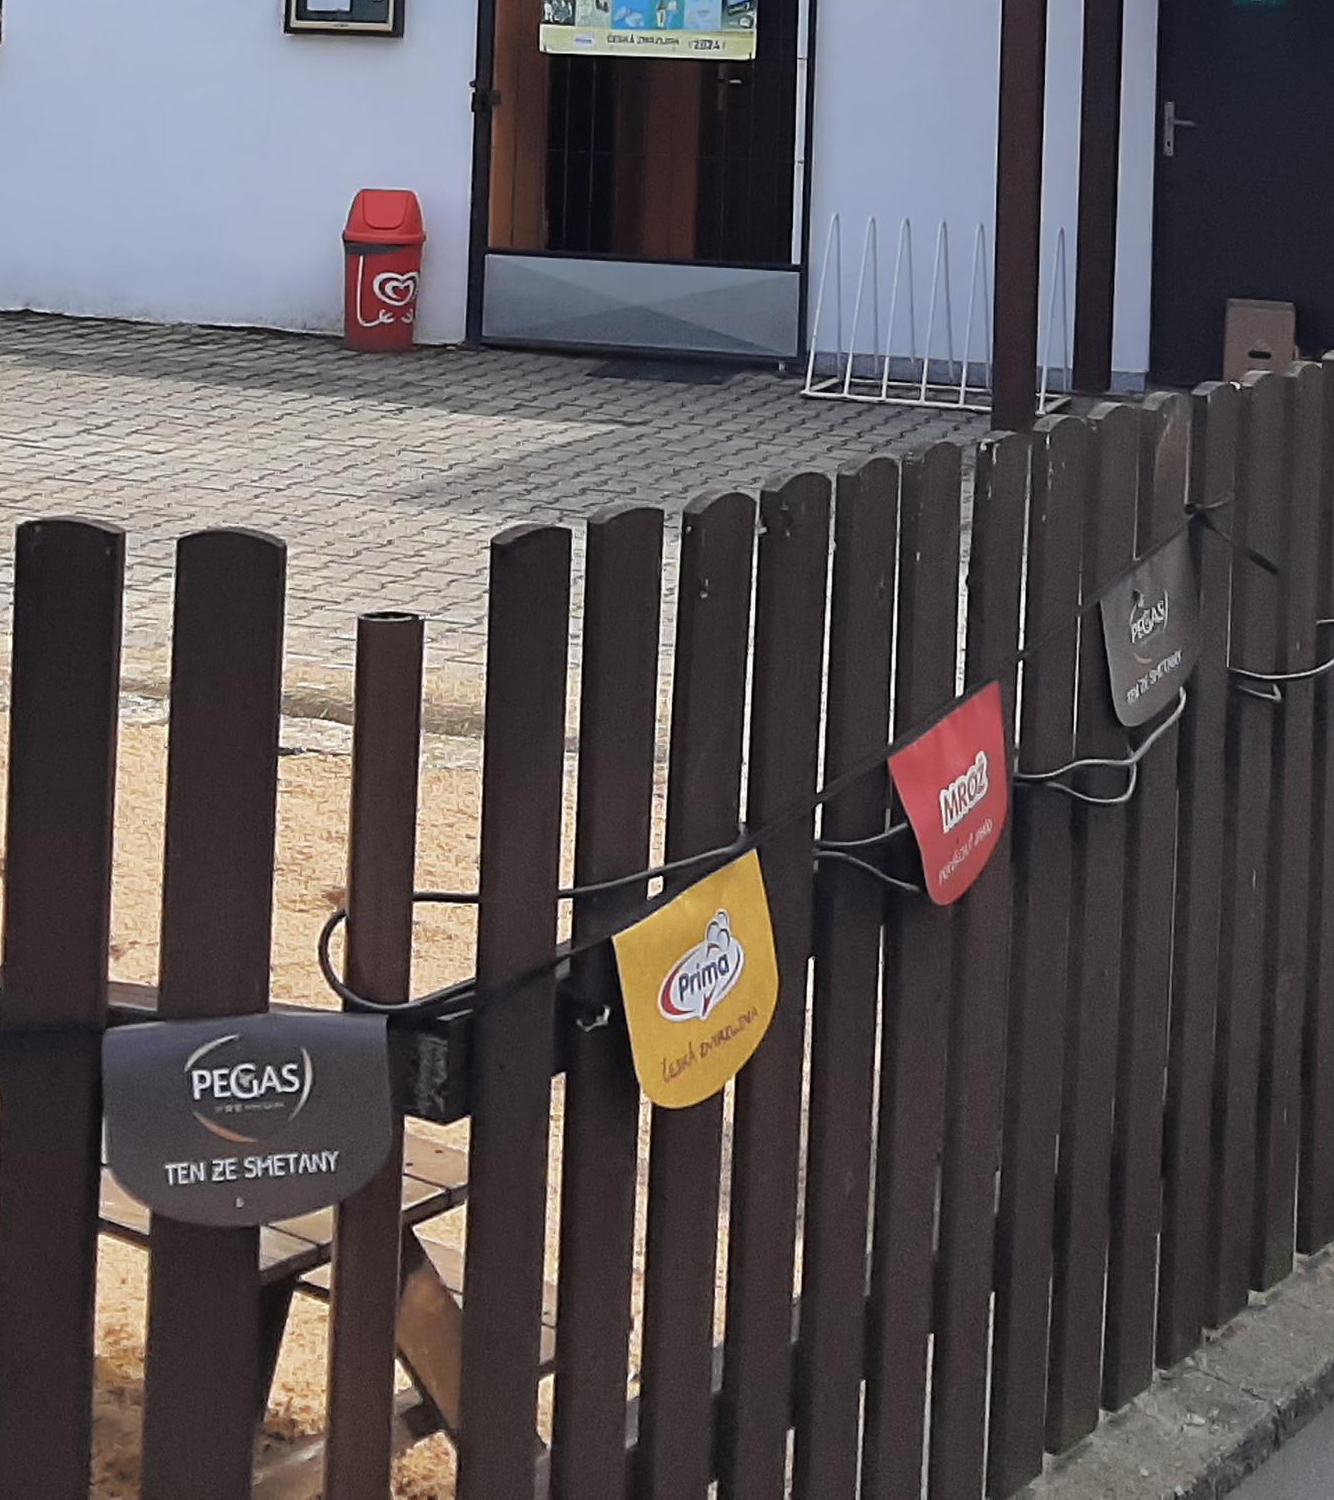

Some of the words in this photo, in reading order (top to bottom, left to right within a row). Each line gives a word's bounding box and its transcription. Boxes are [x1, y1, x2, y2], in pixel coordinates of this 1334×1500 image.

[1130, 599, 1165, 644] PEGAS
[678, 952, 731, 1004] Prima
[190, 1062, 301, 1100] PEGAS
[165, 1160, 206, 1186] TEN
[212, 1156, 238, 1182] ZE
[244, 1150, 340, 1180] SMETANY
